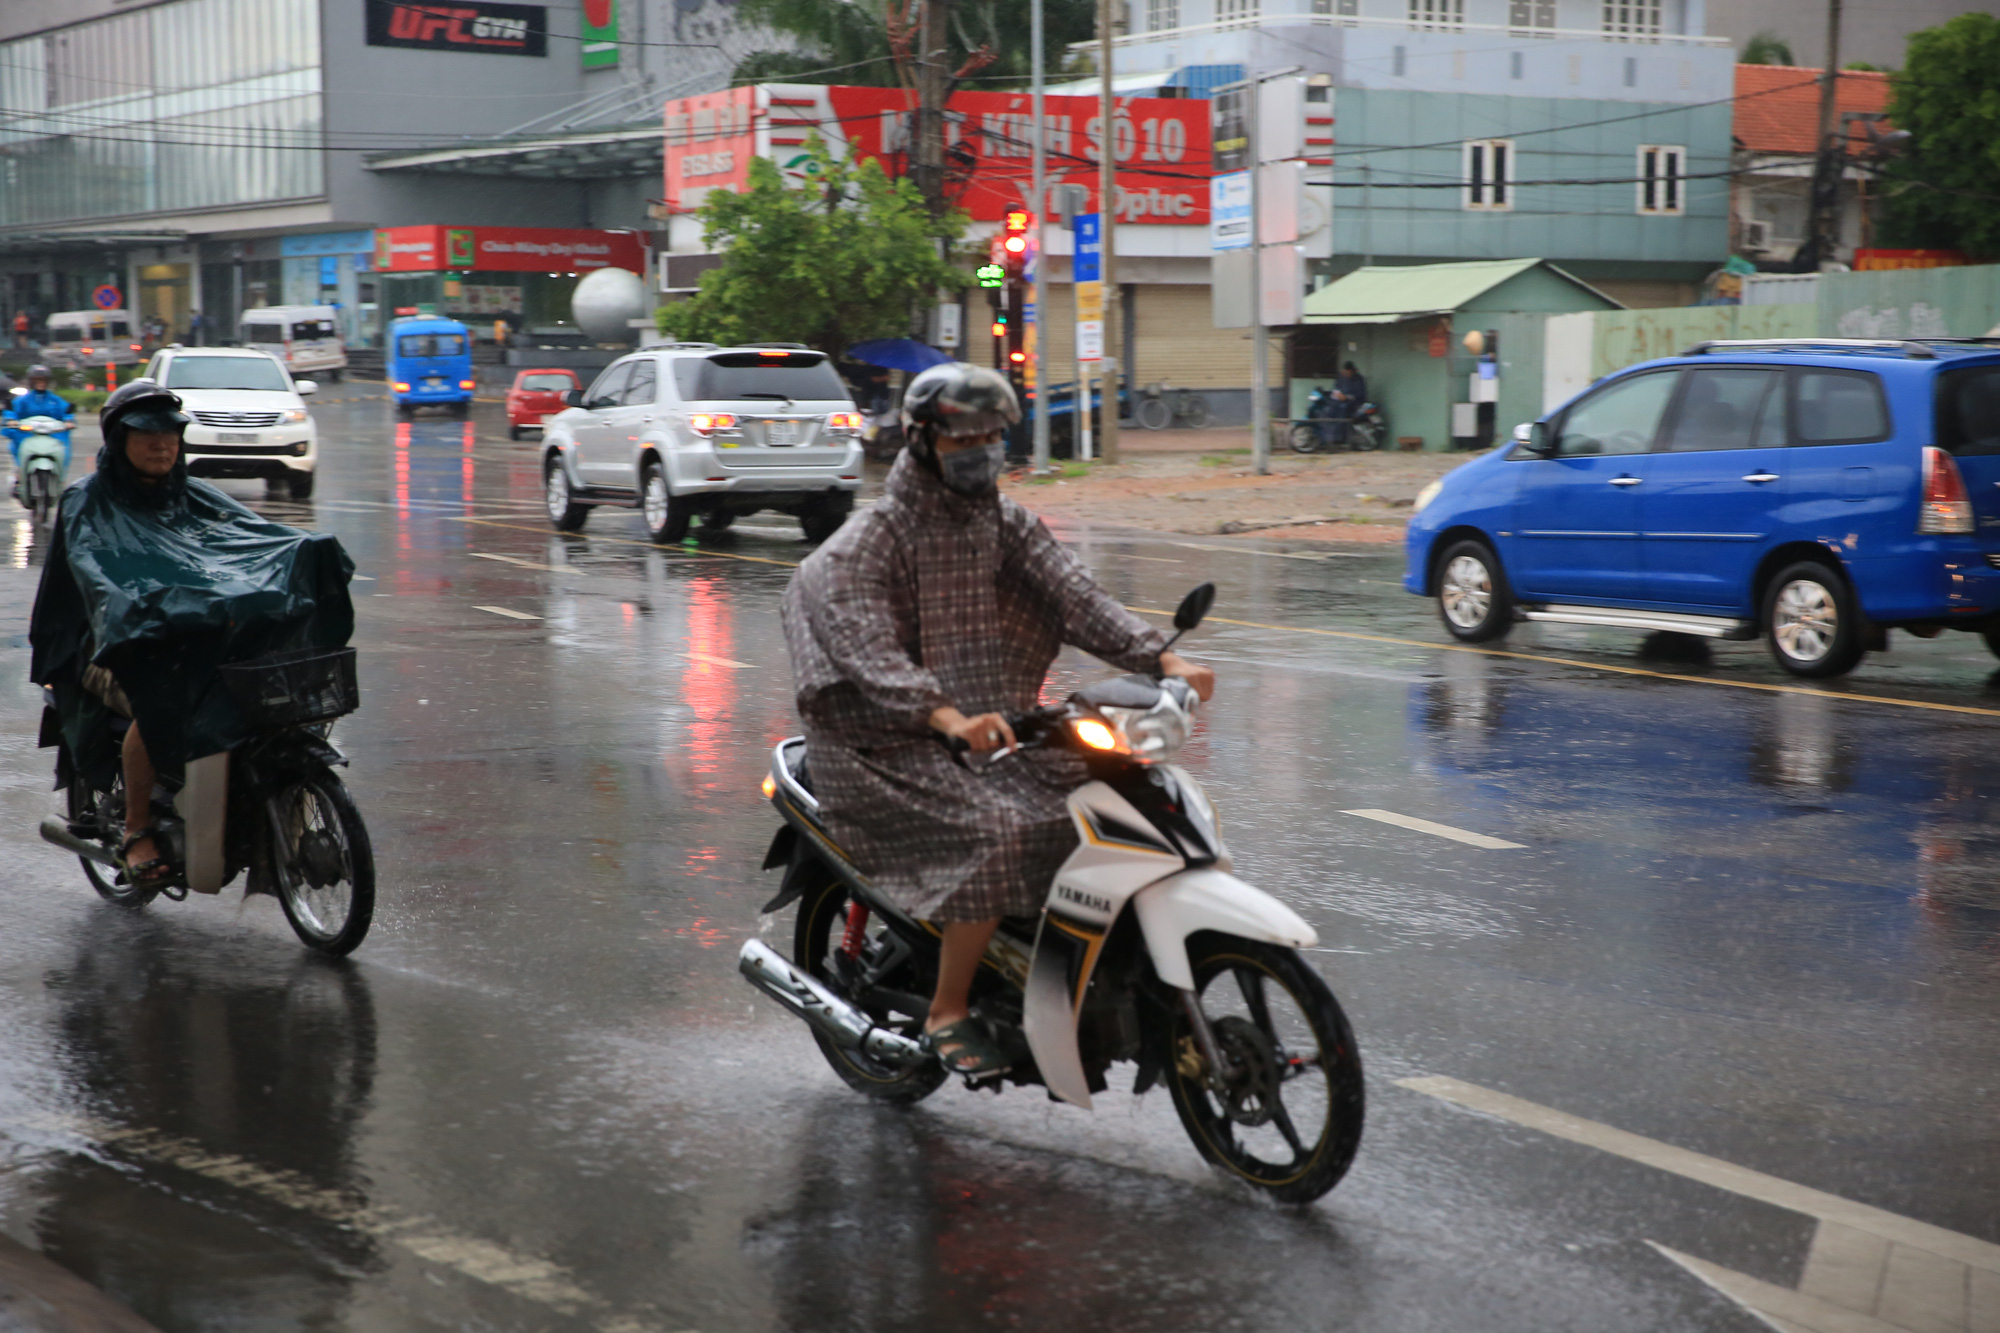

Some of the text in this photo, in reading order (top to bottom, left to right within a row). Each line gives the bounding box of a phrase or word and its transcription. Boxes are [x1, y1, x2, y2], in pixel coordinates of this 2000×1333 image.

[388, 5, 528, 43] UFC GYM
[880, 109, 967, 154] MT
[1141, 117, 1187, 163] 10
[1058, 885, 1111, 913] YAMAHA
